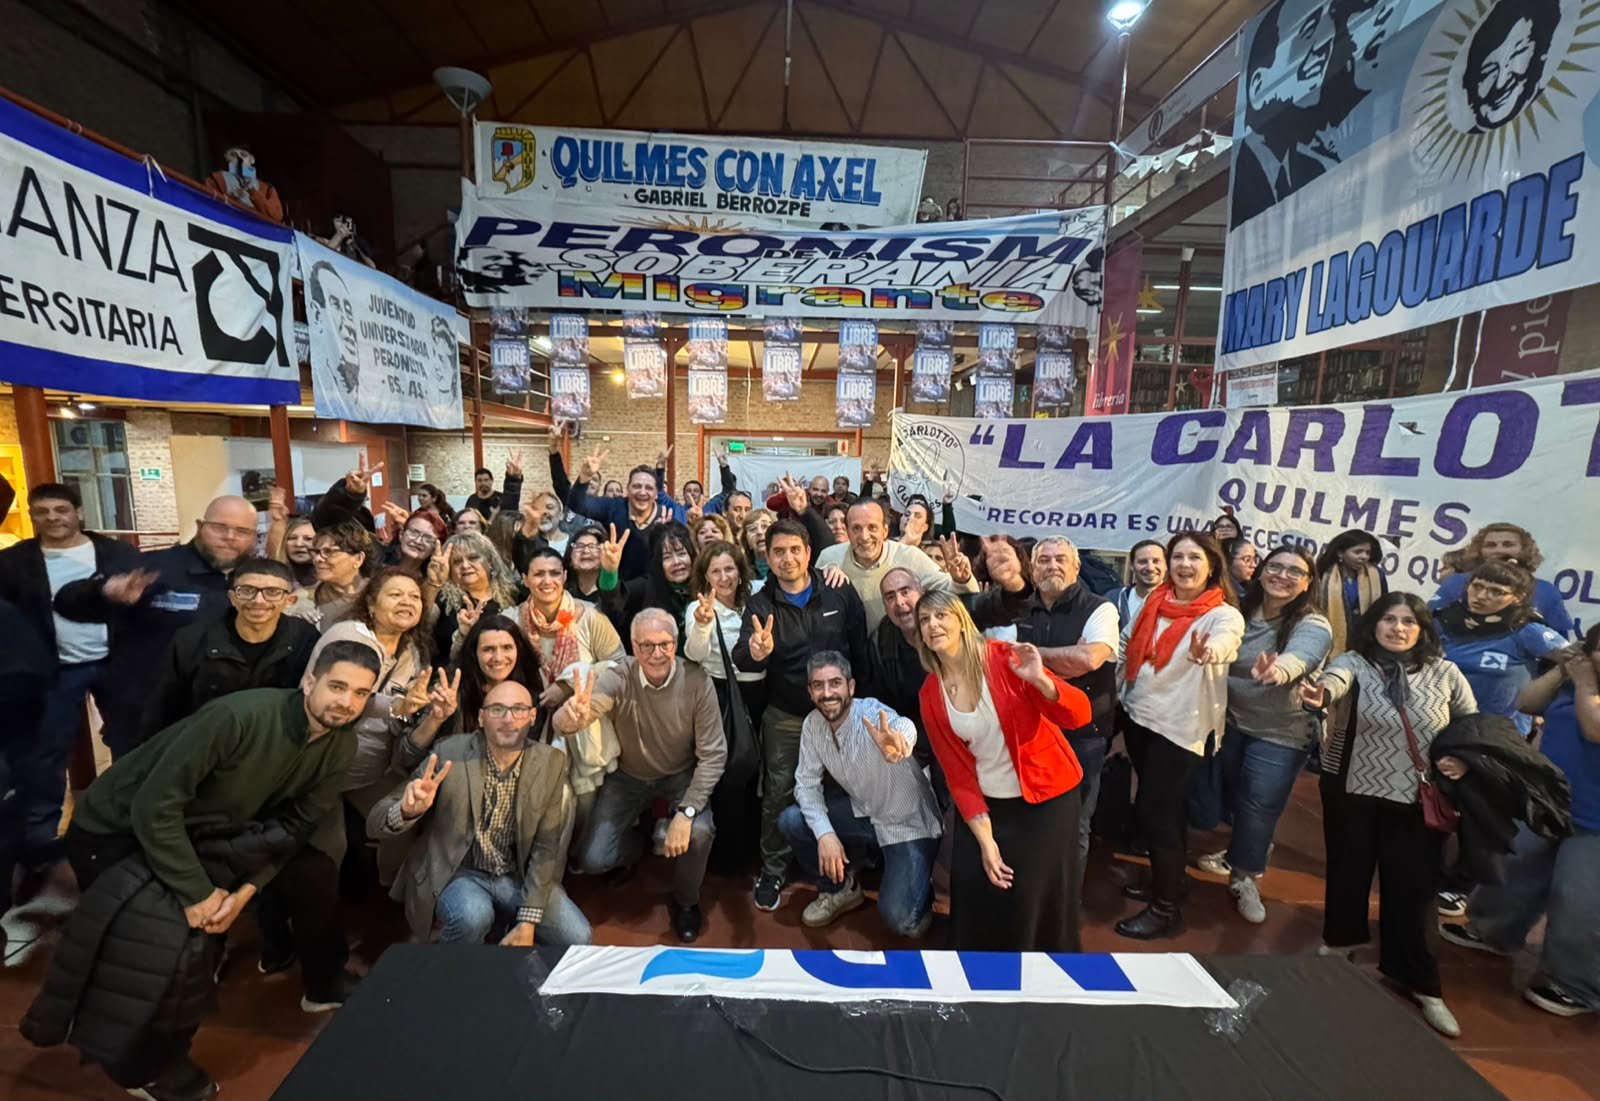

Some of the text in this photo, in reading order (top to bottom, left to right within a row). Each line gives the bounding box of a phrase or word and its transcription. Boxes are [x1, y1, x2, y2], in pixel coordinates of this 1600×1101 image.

[551, 135, 882, 206] QUILMES CON AXEL
[634, 187, 811, 218] GABRIEL BERROZPE
[0, 165, 188, 293] ANZA
[763, 249, 876, 261] DE LA
[1221, 152, 1586, 355] MARY LAGOUARDE
[546, 247, 1079, 292] SOBERANIA
[557, 269, 1046, 313] Migrante
[0, 272, 183, 356] ERSITARIA
[368, 293, 416, 330] JUVENTUD
[843, 326, 876, 345] LIBRE
[494, 345, 527, 367] LIBRE
[628, 348, 661, 369] LIBRE
[767, 353, 799, 373] LIBRE
[917, 356, 949, 375] LIBRE
[1040, 360, 1072, 379] LIBRE
[554, 374, 587, 394] LIBRE
[693, 378, 725, 396] LIBRE
[841, 379, 873, 400] LIBRE
[980, 382, 1012, 402] LIBRE
[1217, 477, 1472, 546] QUILMES
[1128, 514, 1160, 532] ES
